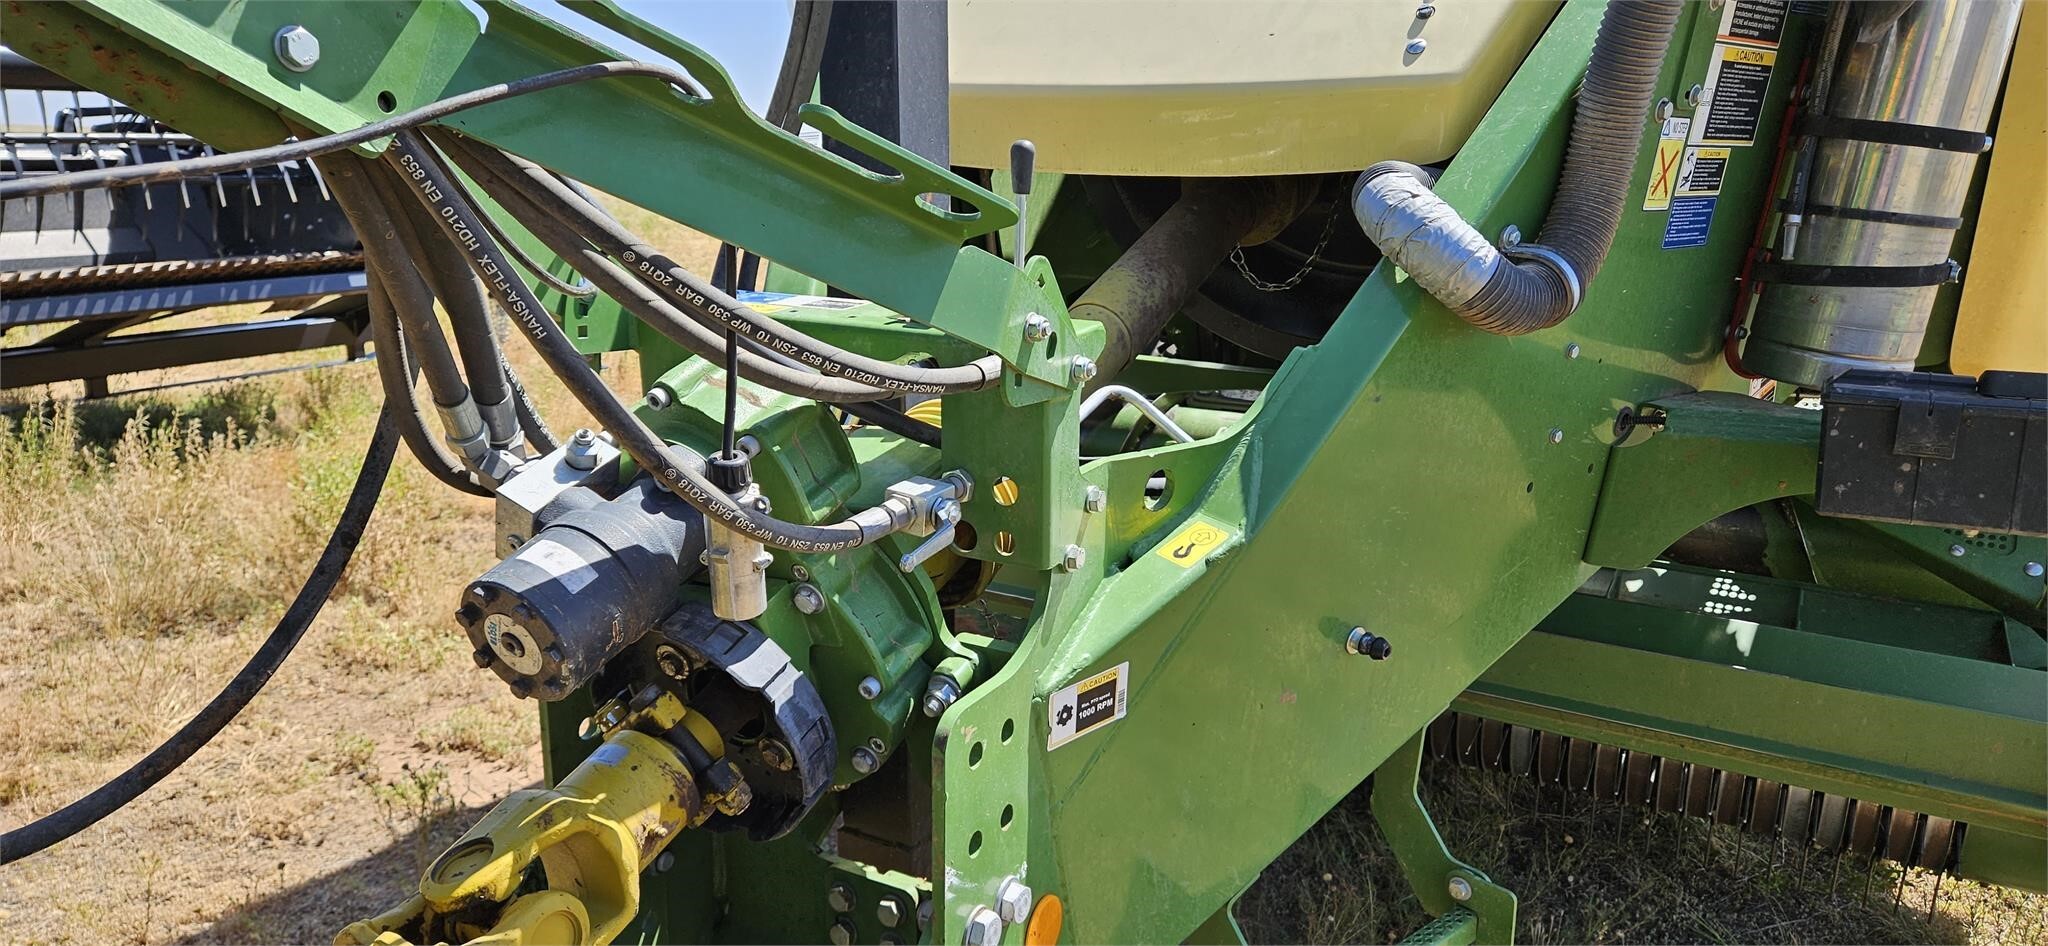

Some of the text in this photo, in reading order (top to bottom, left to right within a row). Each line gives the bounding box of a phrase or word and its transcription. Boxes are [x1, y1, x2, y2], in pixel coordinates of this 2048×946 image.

[1740, 50, 1764, 63] CAUTION
[400, 154, 426, 181] 853
[420, 180, 443, 204] EN
[441, 206, 480, 252] HD210
[640, 260, 673, 286] 2Q18
[476, 254, 547, 340] HANSA-FLEX
[676, 284, 704, 306] BAR
[708, 304, 731, 318] 330
[731, 319, 752, 334] WP
[756, 330, 770, 343] 10
[772, 338, 798, 355] 2SN
[801, 350, 822, 366] 853
[823, 360, 841, 373] EN
[844, 368, 880, 386] HD210
[884, 378, 946, 394] HANSA-FLEX
[678, 478, 708, 502] 2Q18
[708, 502, 735, 521] BAR
[736, 518, 756, 531] 330
[754, 528, 773, 540] WP
[776, 536, 788, 546] 10
[789, 539, 810, 550] 2SN
[813, 542, 830, 551] 853
[830, 542, 844, 550] EN
[1089, 671, 1117, 688] CAUTION
[1100, 692, 1110, 700] speed
[1079, 698, 1113, 720] 1000 RPM
